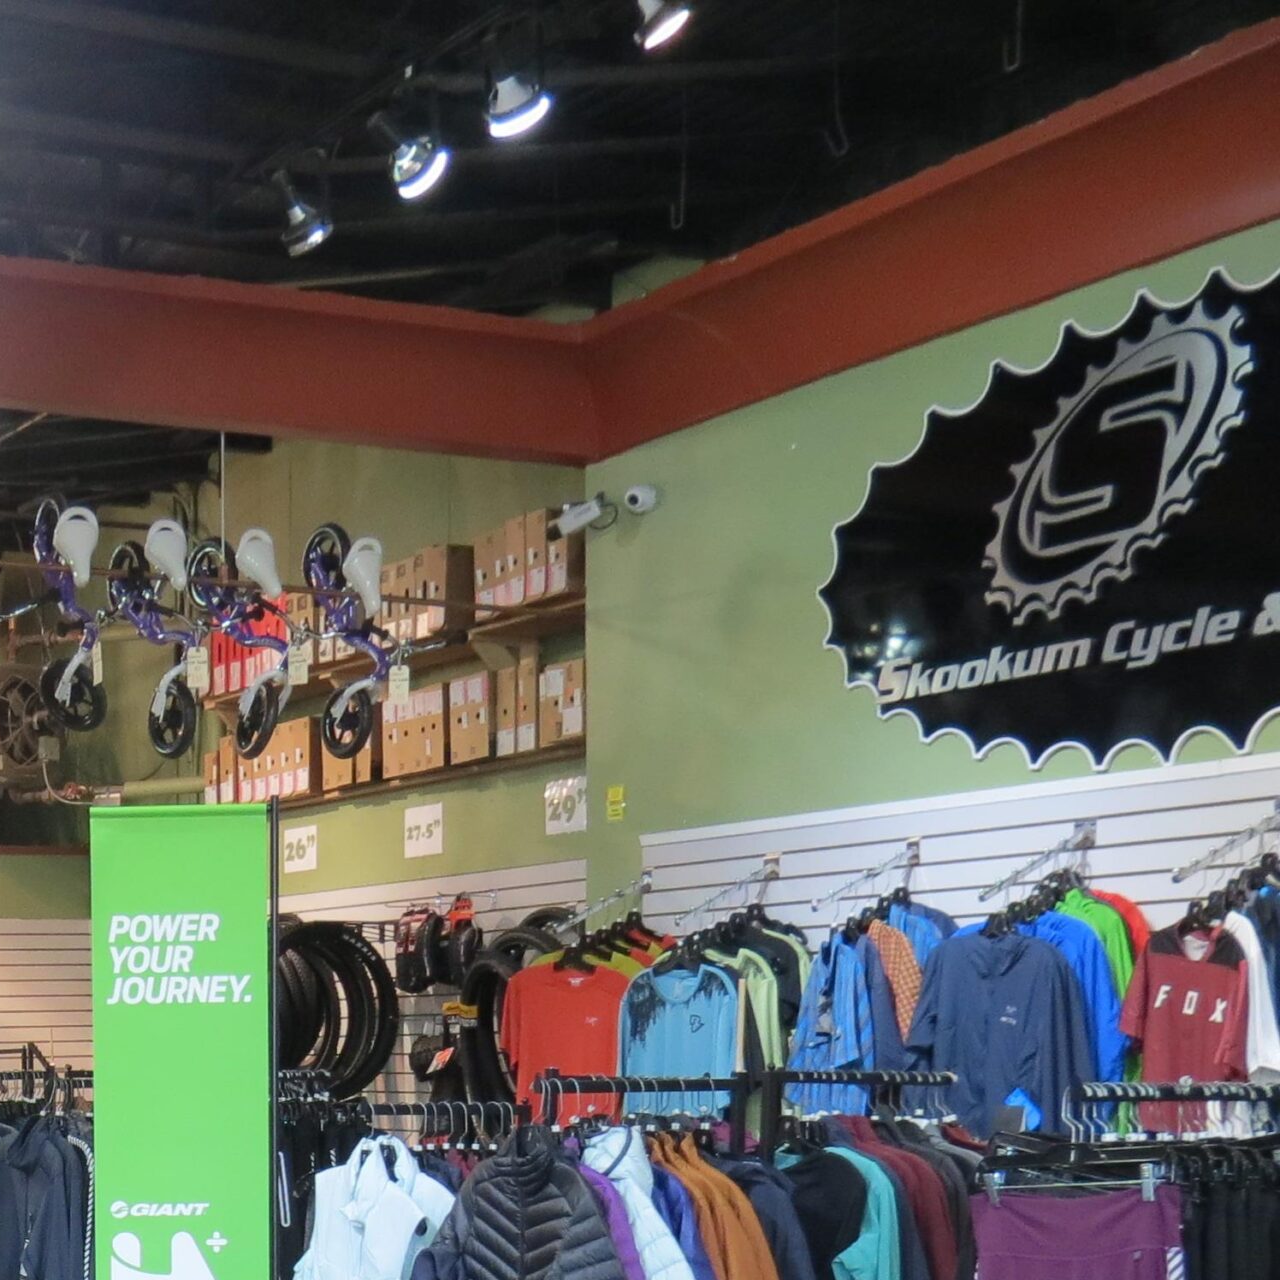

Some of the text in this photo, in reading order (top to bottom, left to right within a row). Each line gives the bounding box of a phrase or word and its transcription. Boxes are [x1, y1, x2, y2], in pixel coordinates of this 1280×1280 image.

[876, 637, 1091, 703] Skookum
[1101, 606, 1240, 669] Cycle
[285, 834, 315, 862] 26"
[108, 914, 220, 942] POWER
[109, 945, 194, 973] YOUR
[107, 975, 252, 1004] JOURNEY.
[1153, 985, 1228, 1023] FOX
[130, 1203, 210, 1217] GIANT
